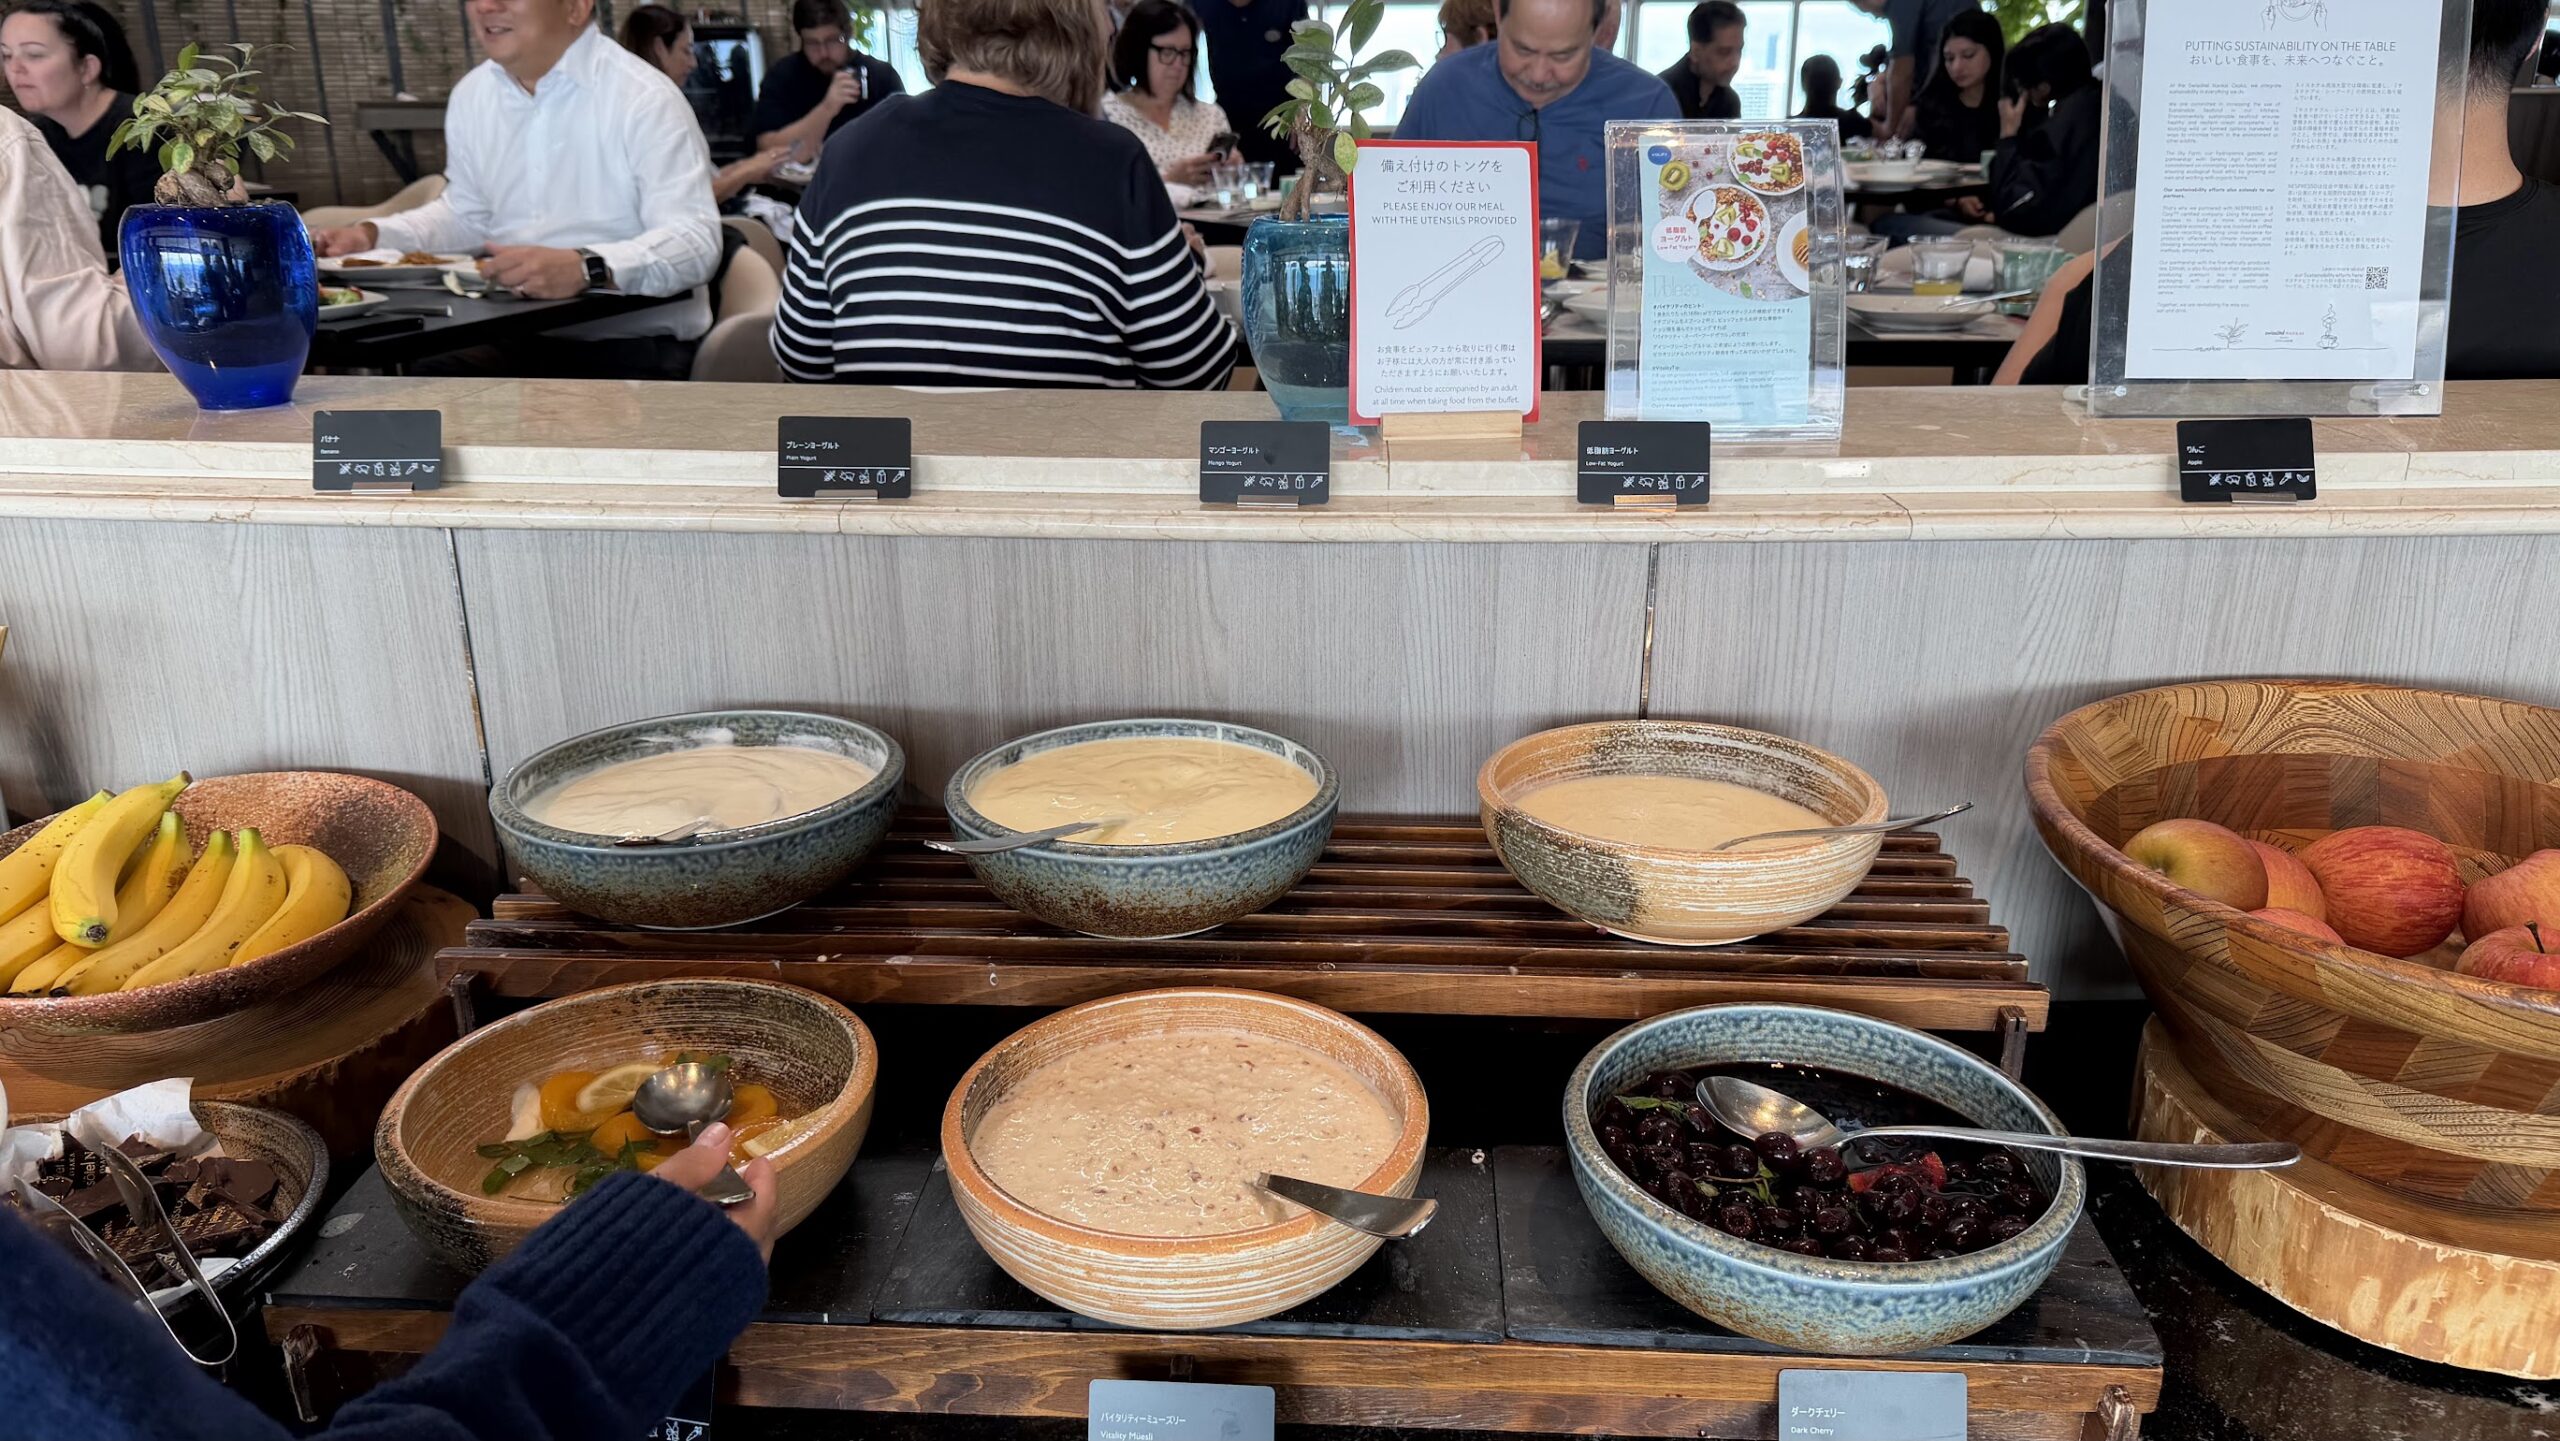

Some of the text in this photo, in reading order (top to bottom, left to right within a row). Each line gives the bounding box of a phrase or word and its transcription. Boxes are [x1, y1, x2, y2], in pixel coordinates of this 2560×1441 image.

[2185, 41, 2397, 51] PUTTING SUSTAINABILITY ON THE TABLE
[1380, 158, 1503, 174] 備え付けのトングを
[1397, 179, 1491, 194] ご利用ください
[1383, 202, 1505, 211] PLEASE ENJOY OUR MEAL
[1371, 216, 1517, 225] WITH THE UTENSILS PROVIDED
[1374, 385, 1404, 394] Children
[1424, 385, 1432, 393] be
[1434, 385, 1479, 395] accompanied
[1480, 385, 1489, 395] by
[1500, 384, 1518, 392] adult
[1390, 398, 1406, 406] time
[1428, 397, 1448, 406] taking
[1449, 397, 1466, 405] food
[786, 441, 840, 449] プレーンヨーグルト
[1208, 446, 1260, 454] マンゴーヨーグルト
[1791, 1406, 1846, 1418] ダークチェリー
[1100, 1412, 1187, 1425] バイタリティーミューズリー
[1100, 1430, 1127, 1441] Vitality
[1810, 1427, 1834, 1436] Cherry
